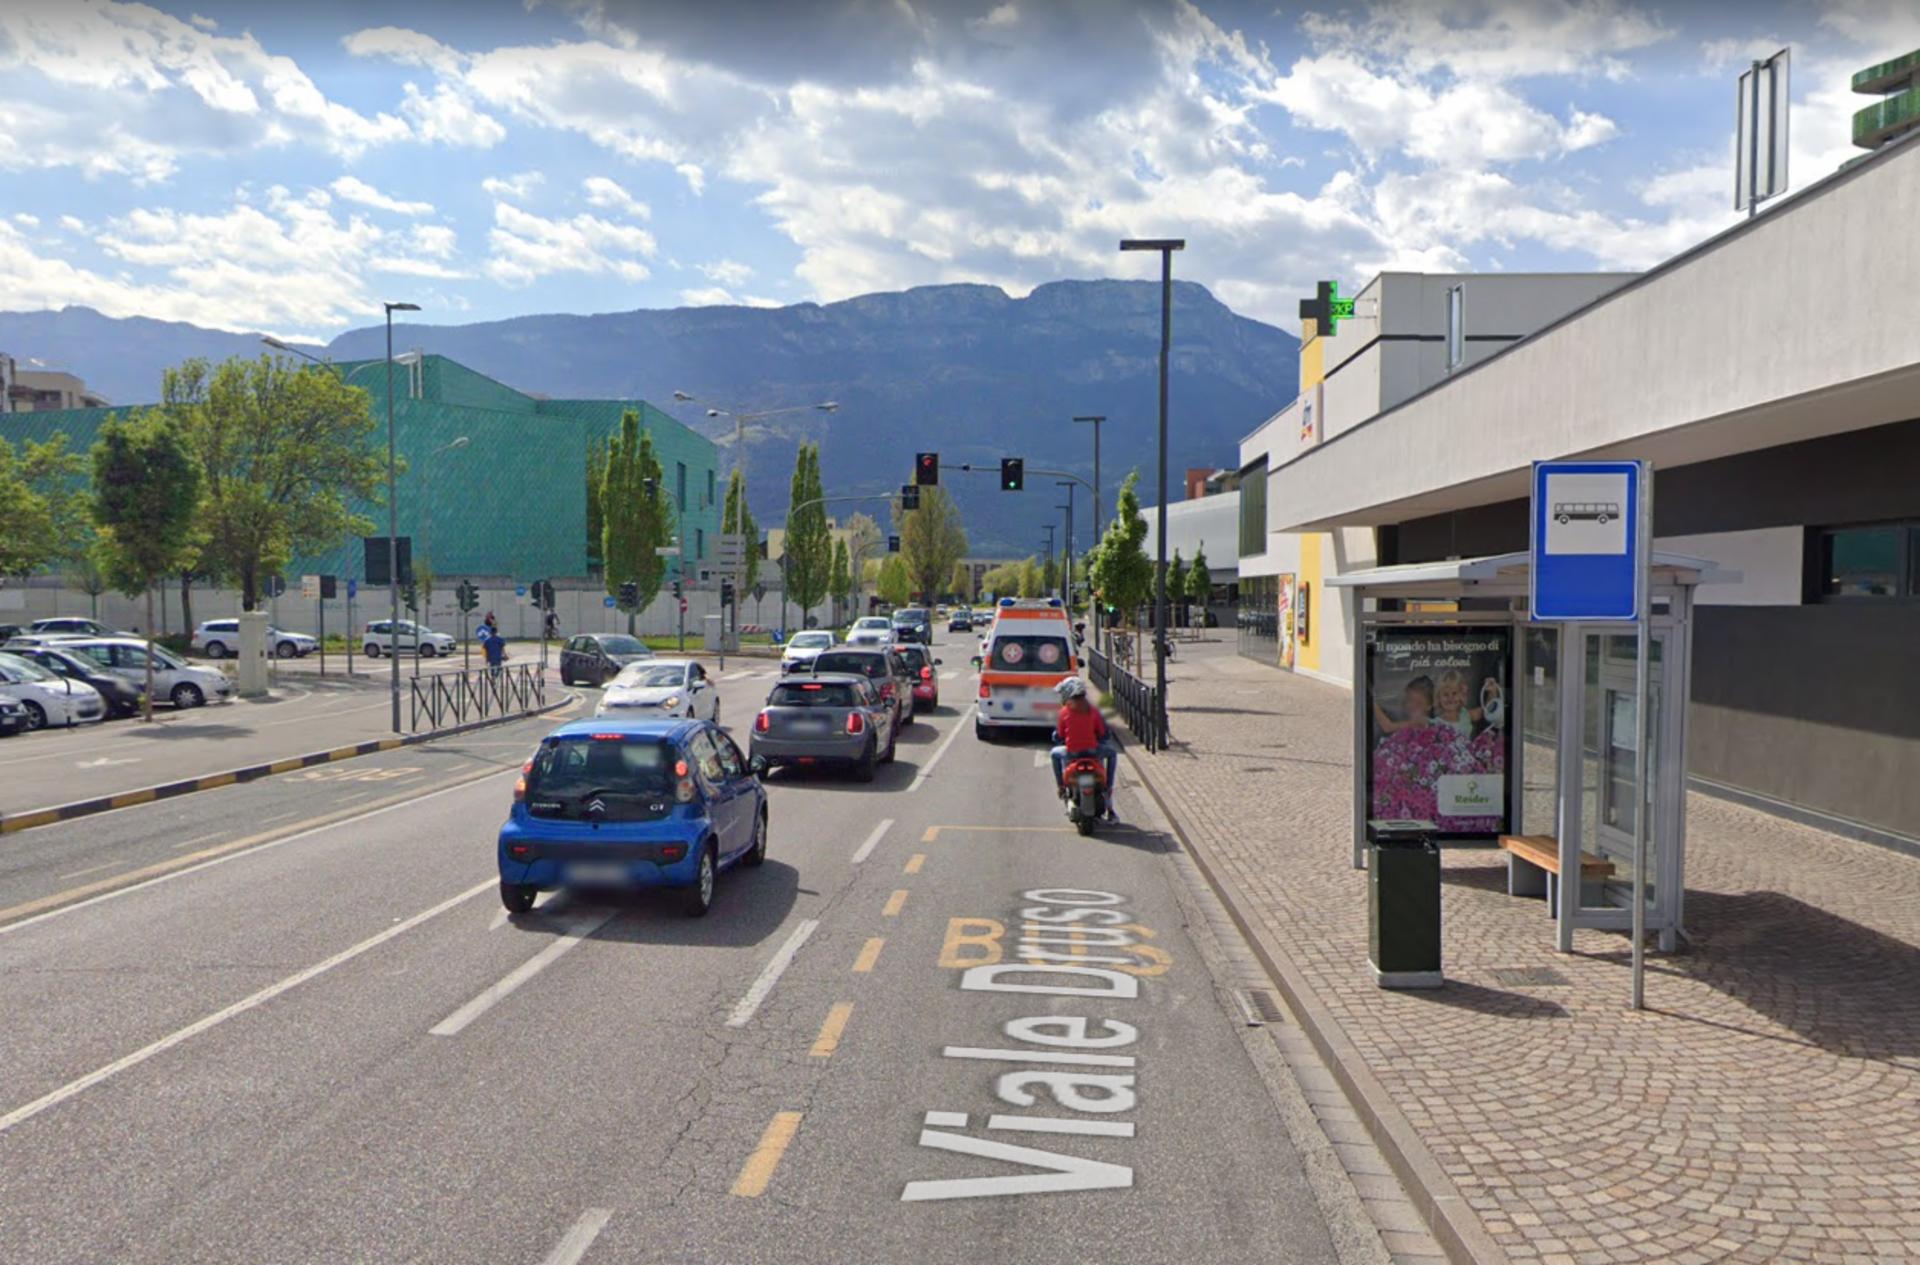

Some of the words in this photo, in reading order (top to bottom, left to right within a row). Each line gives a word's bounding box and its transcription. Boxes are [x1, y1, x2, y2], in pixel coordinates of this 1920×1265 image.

[1427, 641, 1441, 651] ha
[1443, 641, 1487, 653] bisogno
[1488, 640, 1500, 651] di
